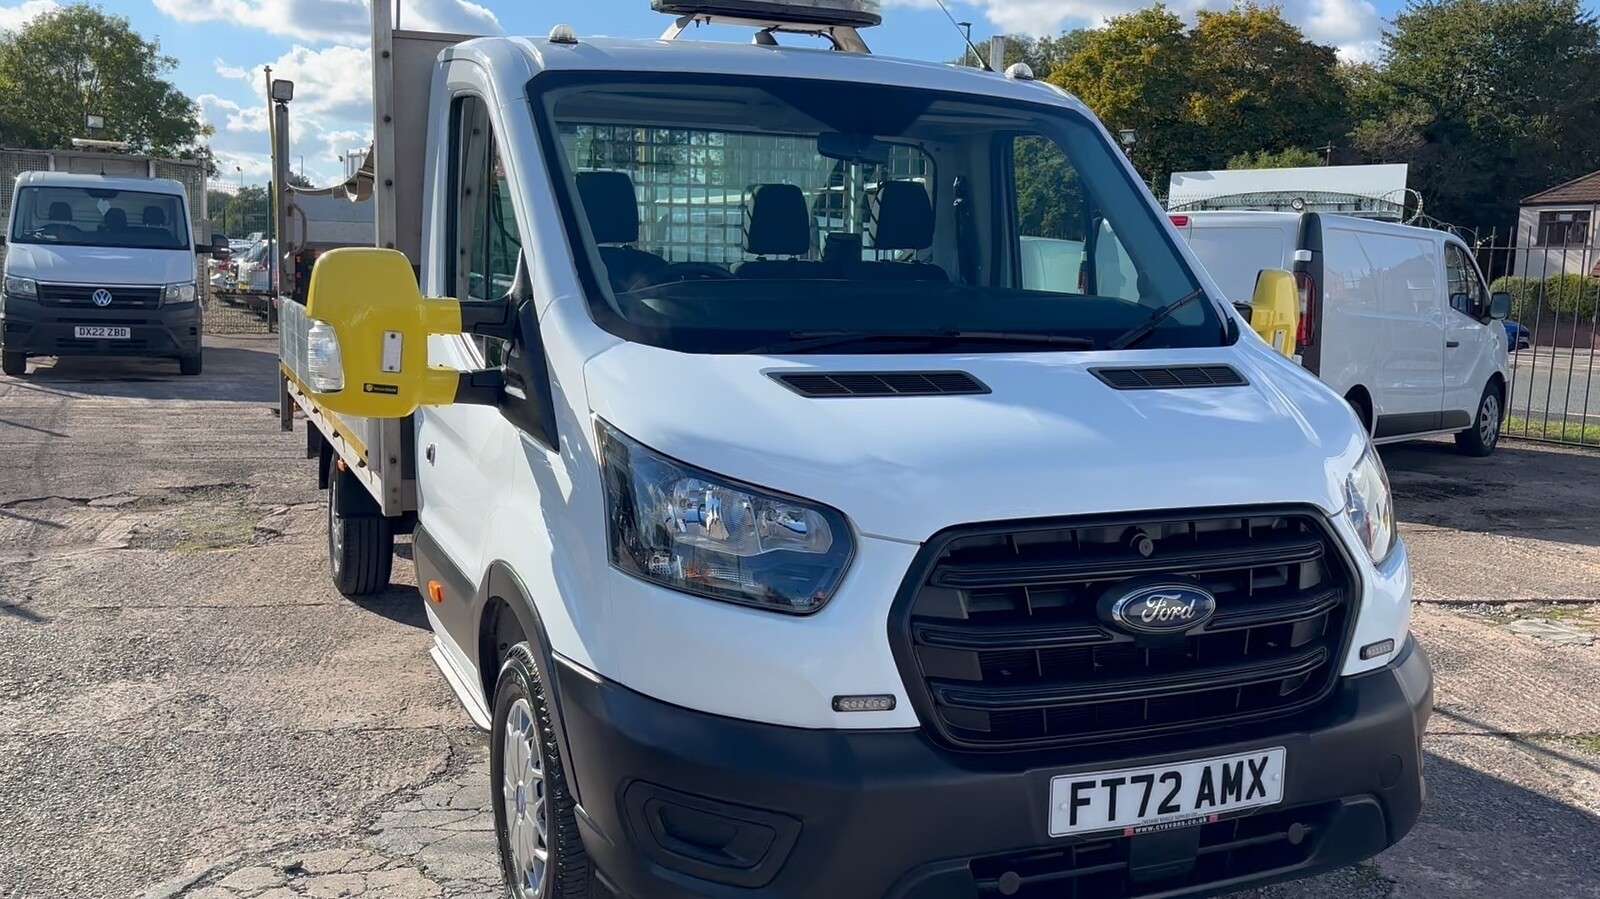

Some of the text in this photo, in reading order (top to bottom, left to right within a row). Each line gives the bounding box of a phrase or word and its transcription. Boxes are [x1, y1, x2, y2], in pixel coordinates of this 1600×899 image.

[79, 327, 127, 337] DX22 ZBD
[1141, 594, 1196, 623] Ford
[1069, 756, 1269, 826] FT72 AMX
